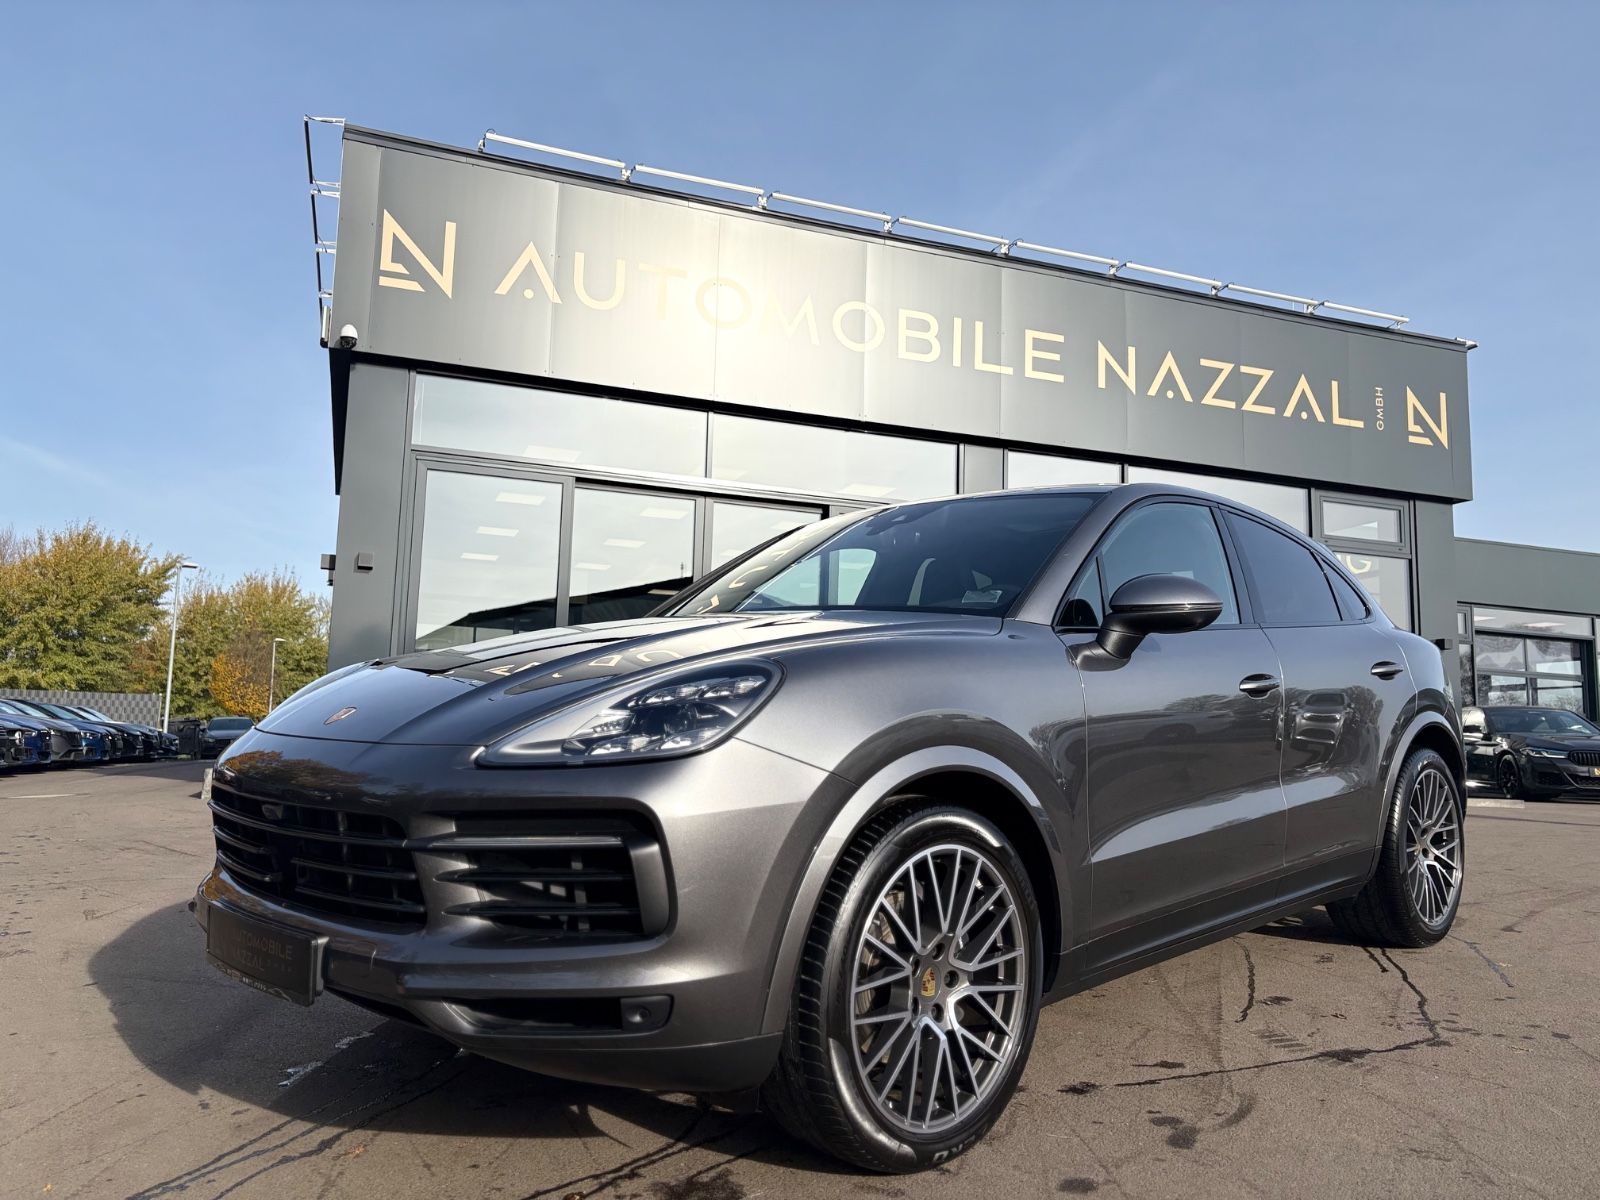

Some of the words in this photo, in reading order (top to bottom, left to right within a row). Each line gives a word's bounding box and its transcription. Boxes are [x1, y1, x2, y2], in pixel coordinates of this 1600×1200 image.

[493, 240, 1065, 384] AUTOMOBILE
[1097, 339, 1365, 429] NAZZAL
[1375, 386, 1385, 431] GMBH
[232, 928, 294, 961] UTOMOBILE
